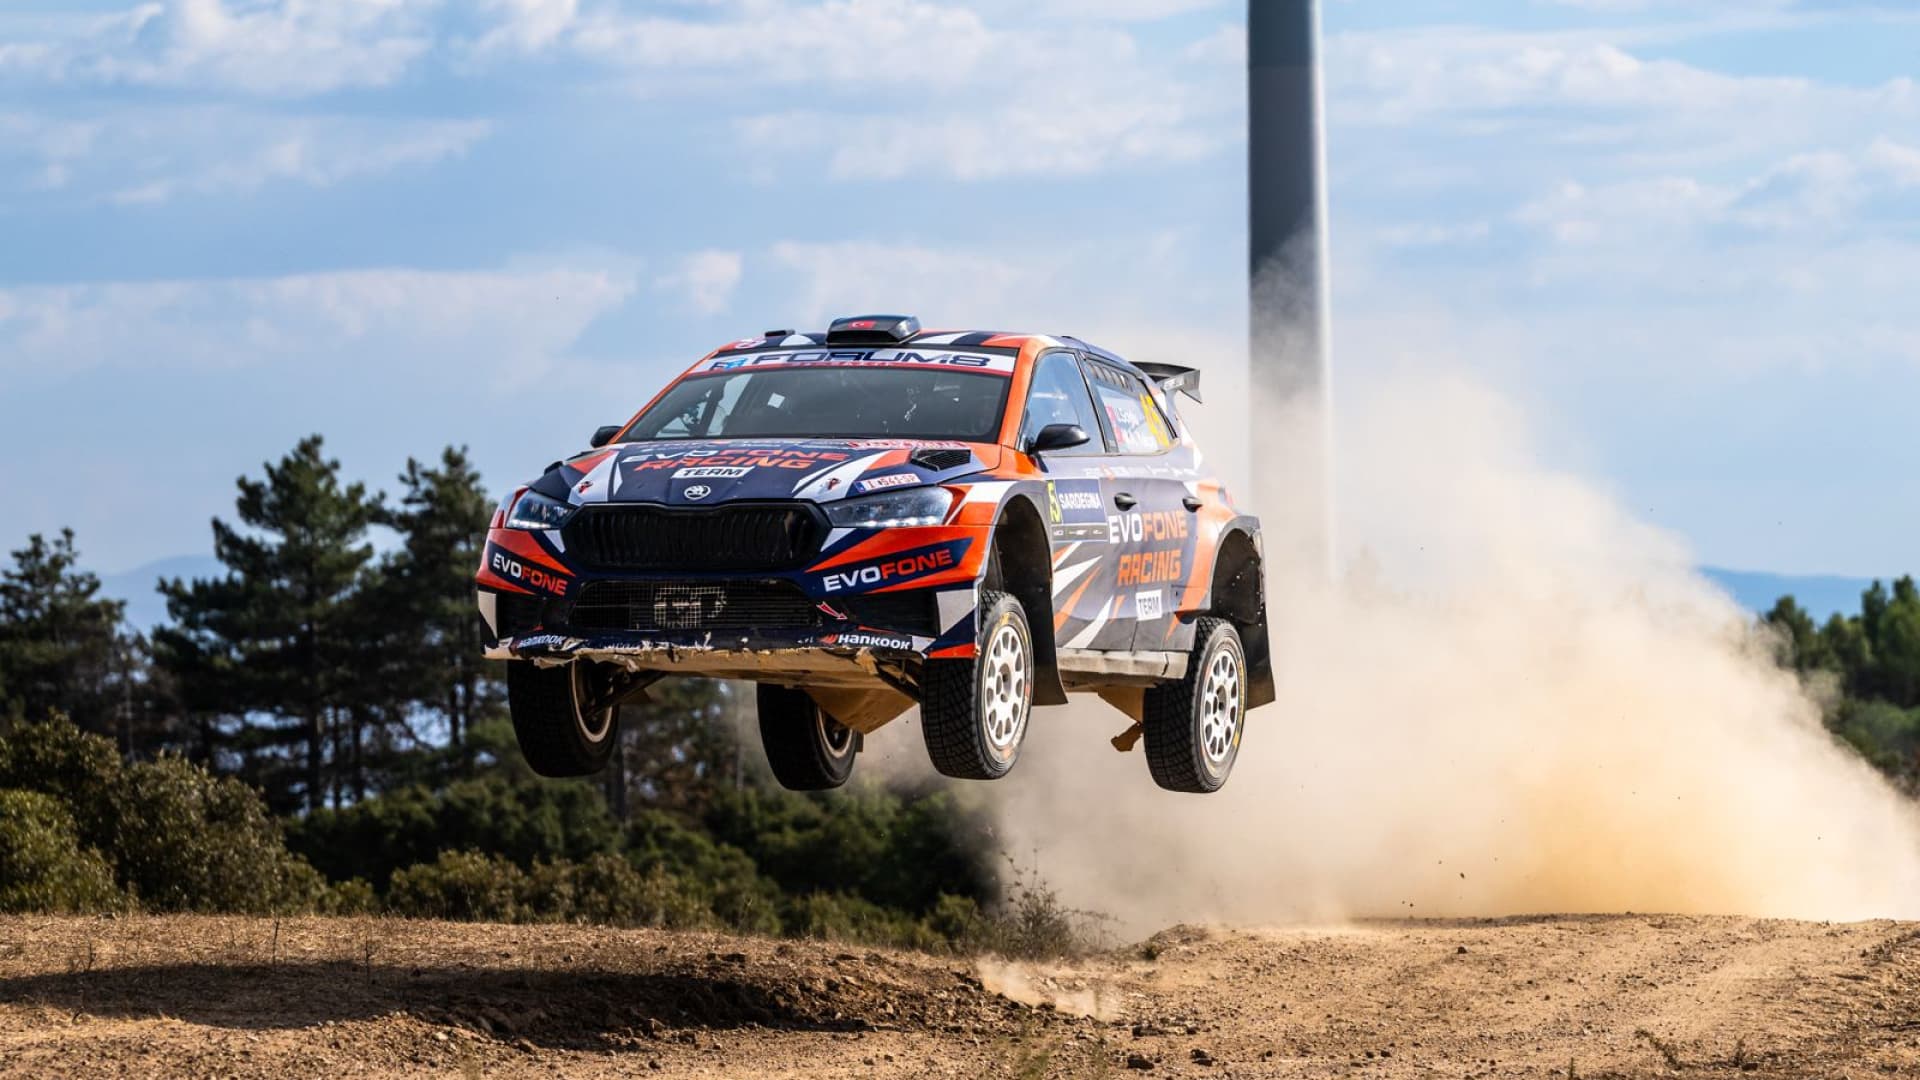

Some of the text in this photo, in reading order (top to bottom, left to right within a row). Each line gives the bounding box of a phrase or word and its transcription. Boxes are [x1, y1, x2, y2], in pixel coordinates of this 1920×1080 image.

[752, 350, 991, 367] FORUM8
[621, 449, 850, 463] EVOFONE
[634, 455, 816, 471] RACING
[1058, 492, 1103, 509] SARDEGNA
[1107, 509, 1189, 544] EVOFONE
[492, 552, 568, 596] EVOFONE
[823, 549, 953, 592] EVOFONE
[1117, 549, 1182, 586] RACING
